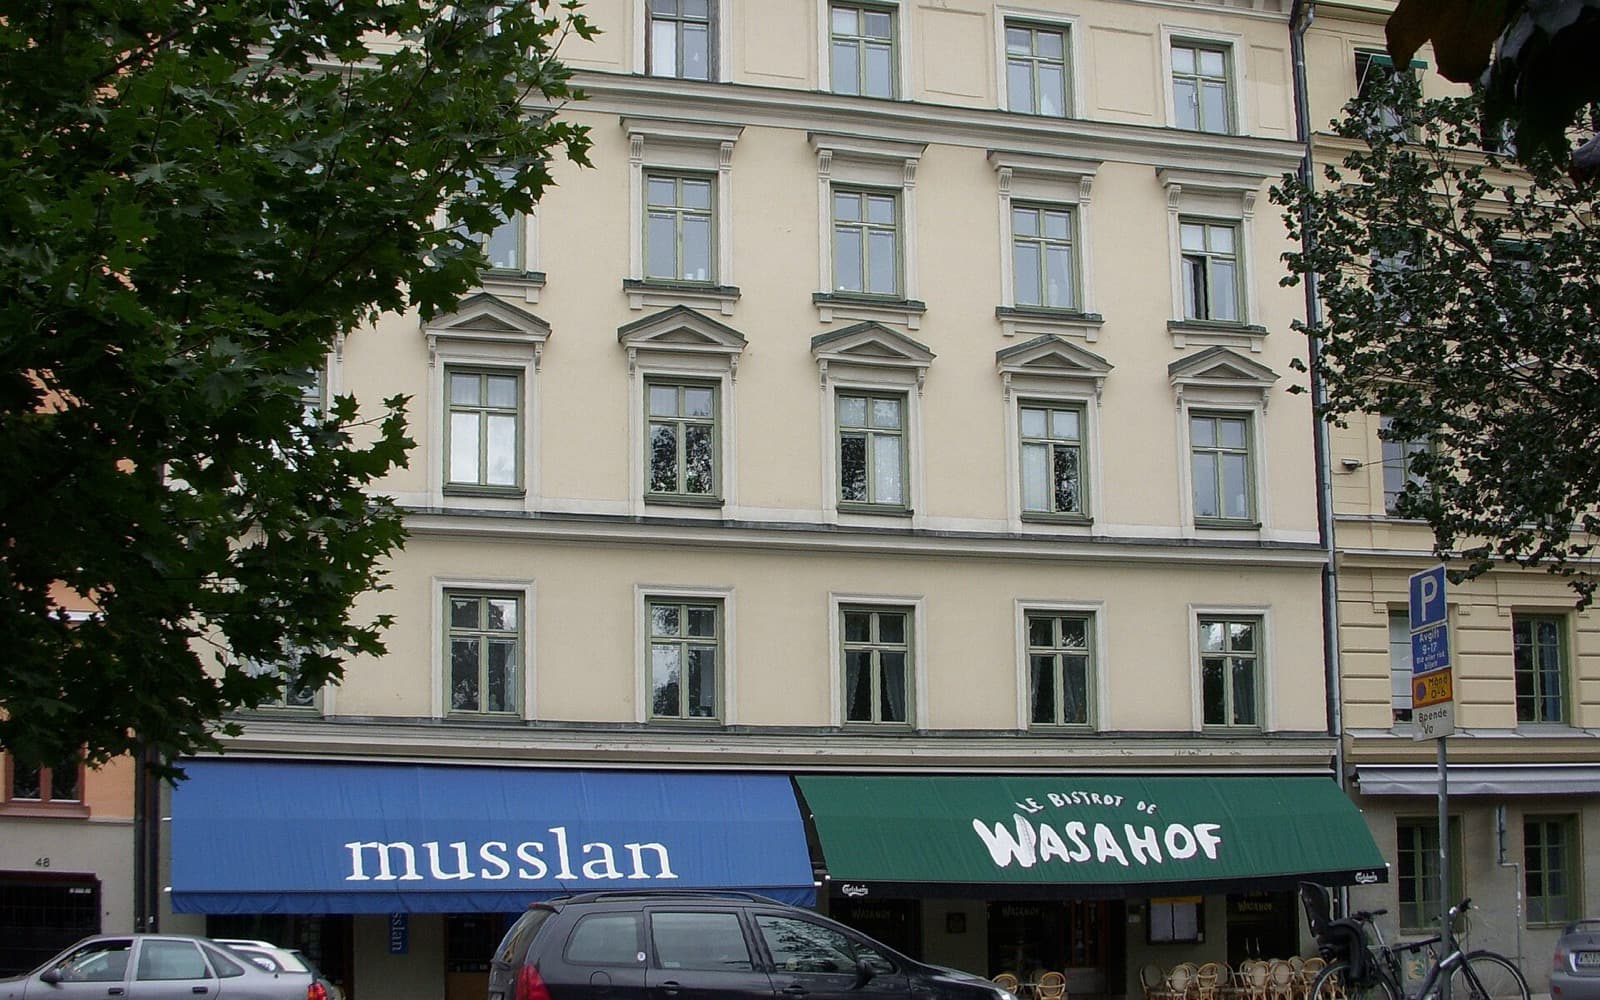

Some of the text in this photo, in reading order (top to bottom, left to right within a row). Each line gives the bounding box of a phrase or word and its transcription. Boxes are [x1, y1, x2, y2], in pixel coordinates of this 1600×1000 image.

[1421, 576, 1438, 622] P
[1419, 629, 1440, 643] Avgift
[1015, 791, 1157, 815] LE BISTROT DE
[345, 826, 679, 880] musslan
[972, 813, 1222, 868] WASAHOF
[35, 857, 50, 868] 48
